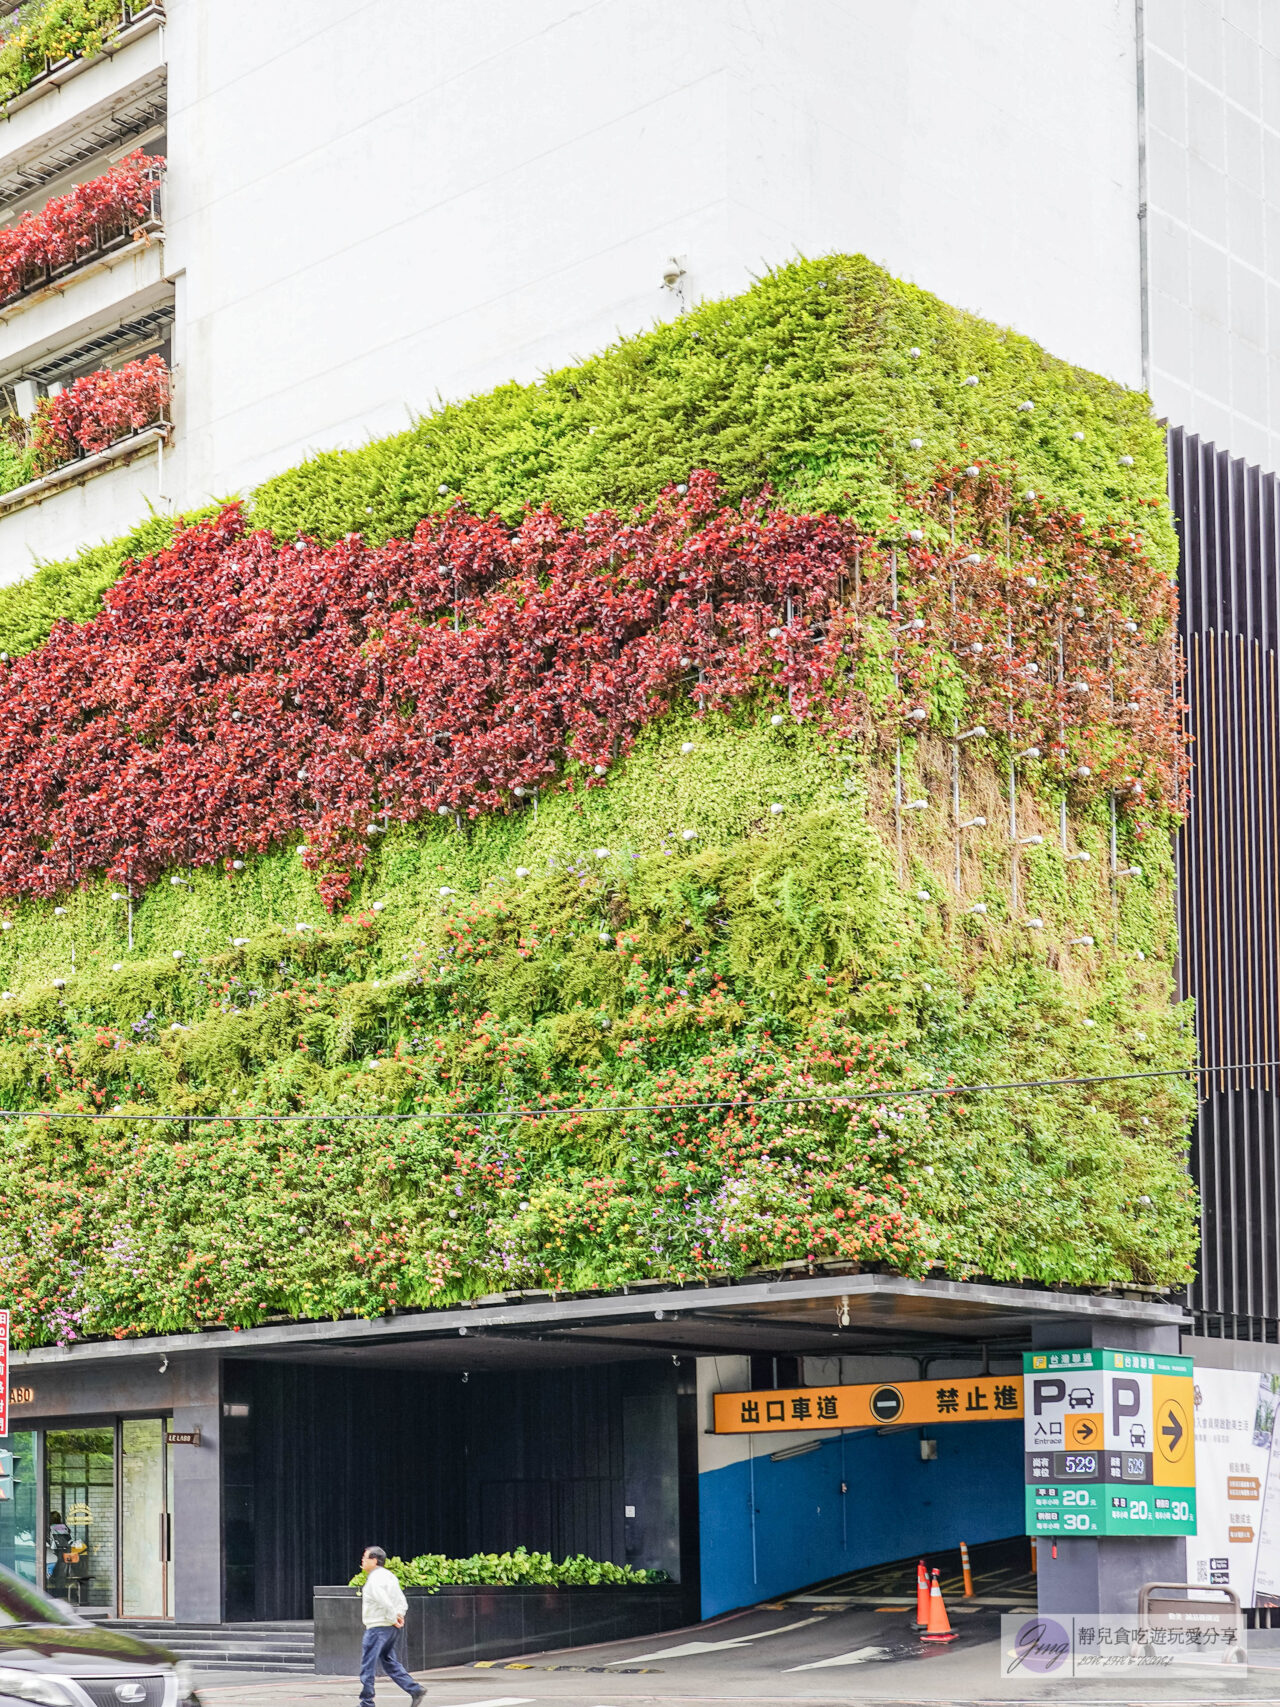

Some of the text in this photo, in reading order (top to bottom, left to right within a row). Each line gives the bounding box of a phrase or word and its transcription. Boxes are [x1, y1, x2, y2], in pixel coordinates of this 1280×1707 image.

[9, 1388, 33, 1404] ABO
[936, 1385, 1018, 1413] 禁止進
[1033, 1379, 1066, 1416] P
[740, 1396, 839, 1423] 出口車道
[1112, 1377, 1140, 1436] P
[1034, 1422, 1062, 1435] 入口
[1065, 1456, 1096, 1473] 529
[1127, 1457, 1144, 1474] 529
[1038, 1488, 1056, 1496] 平日
